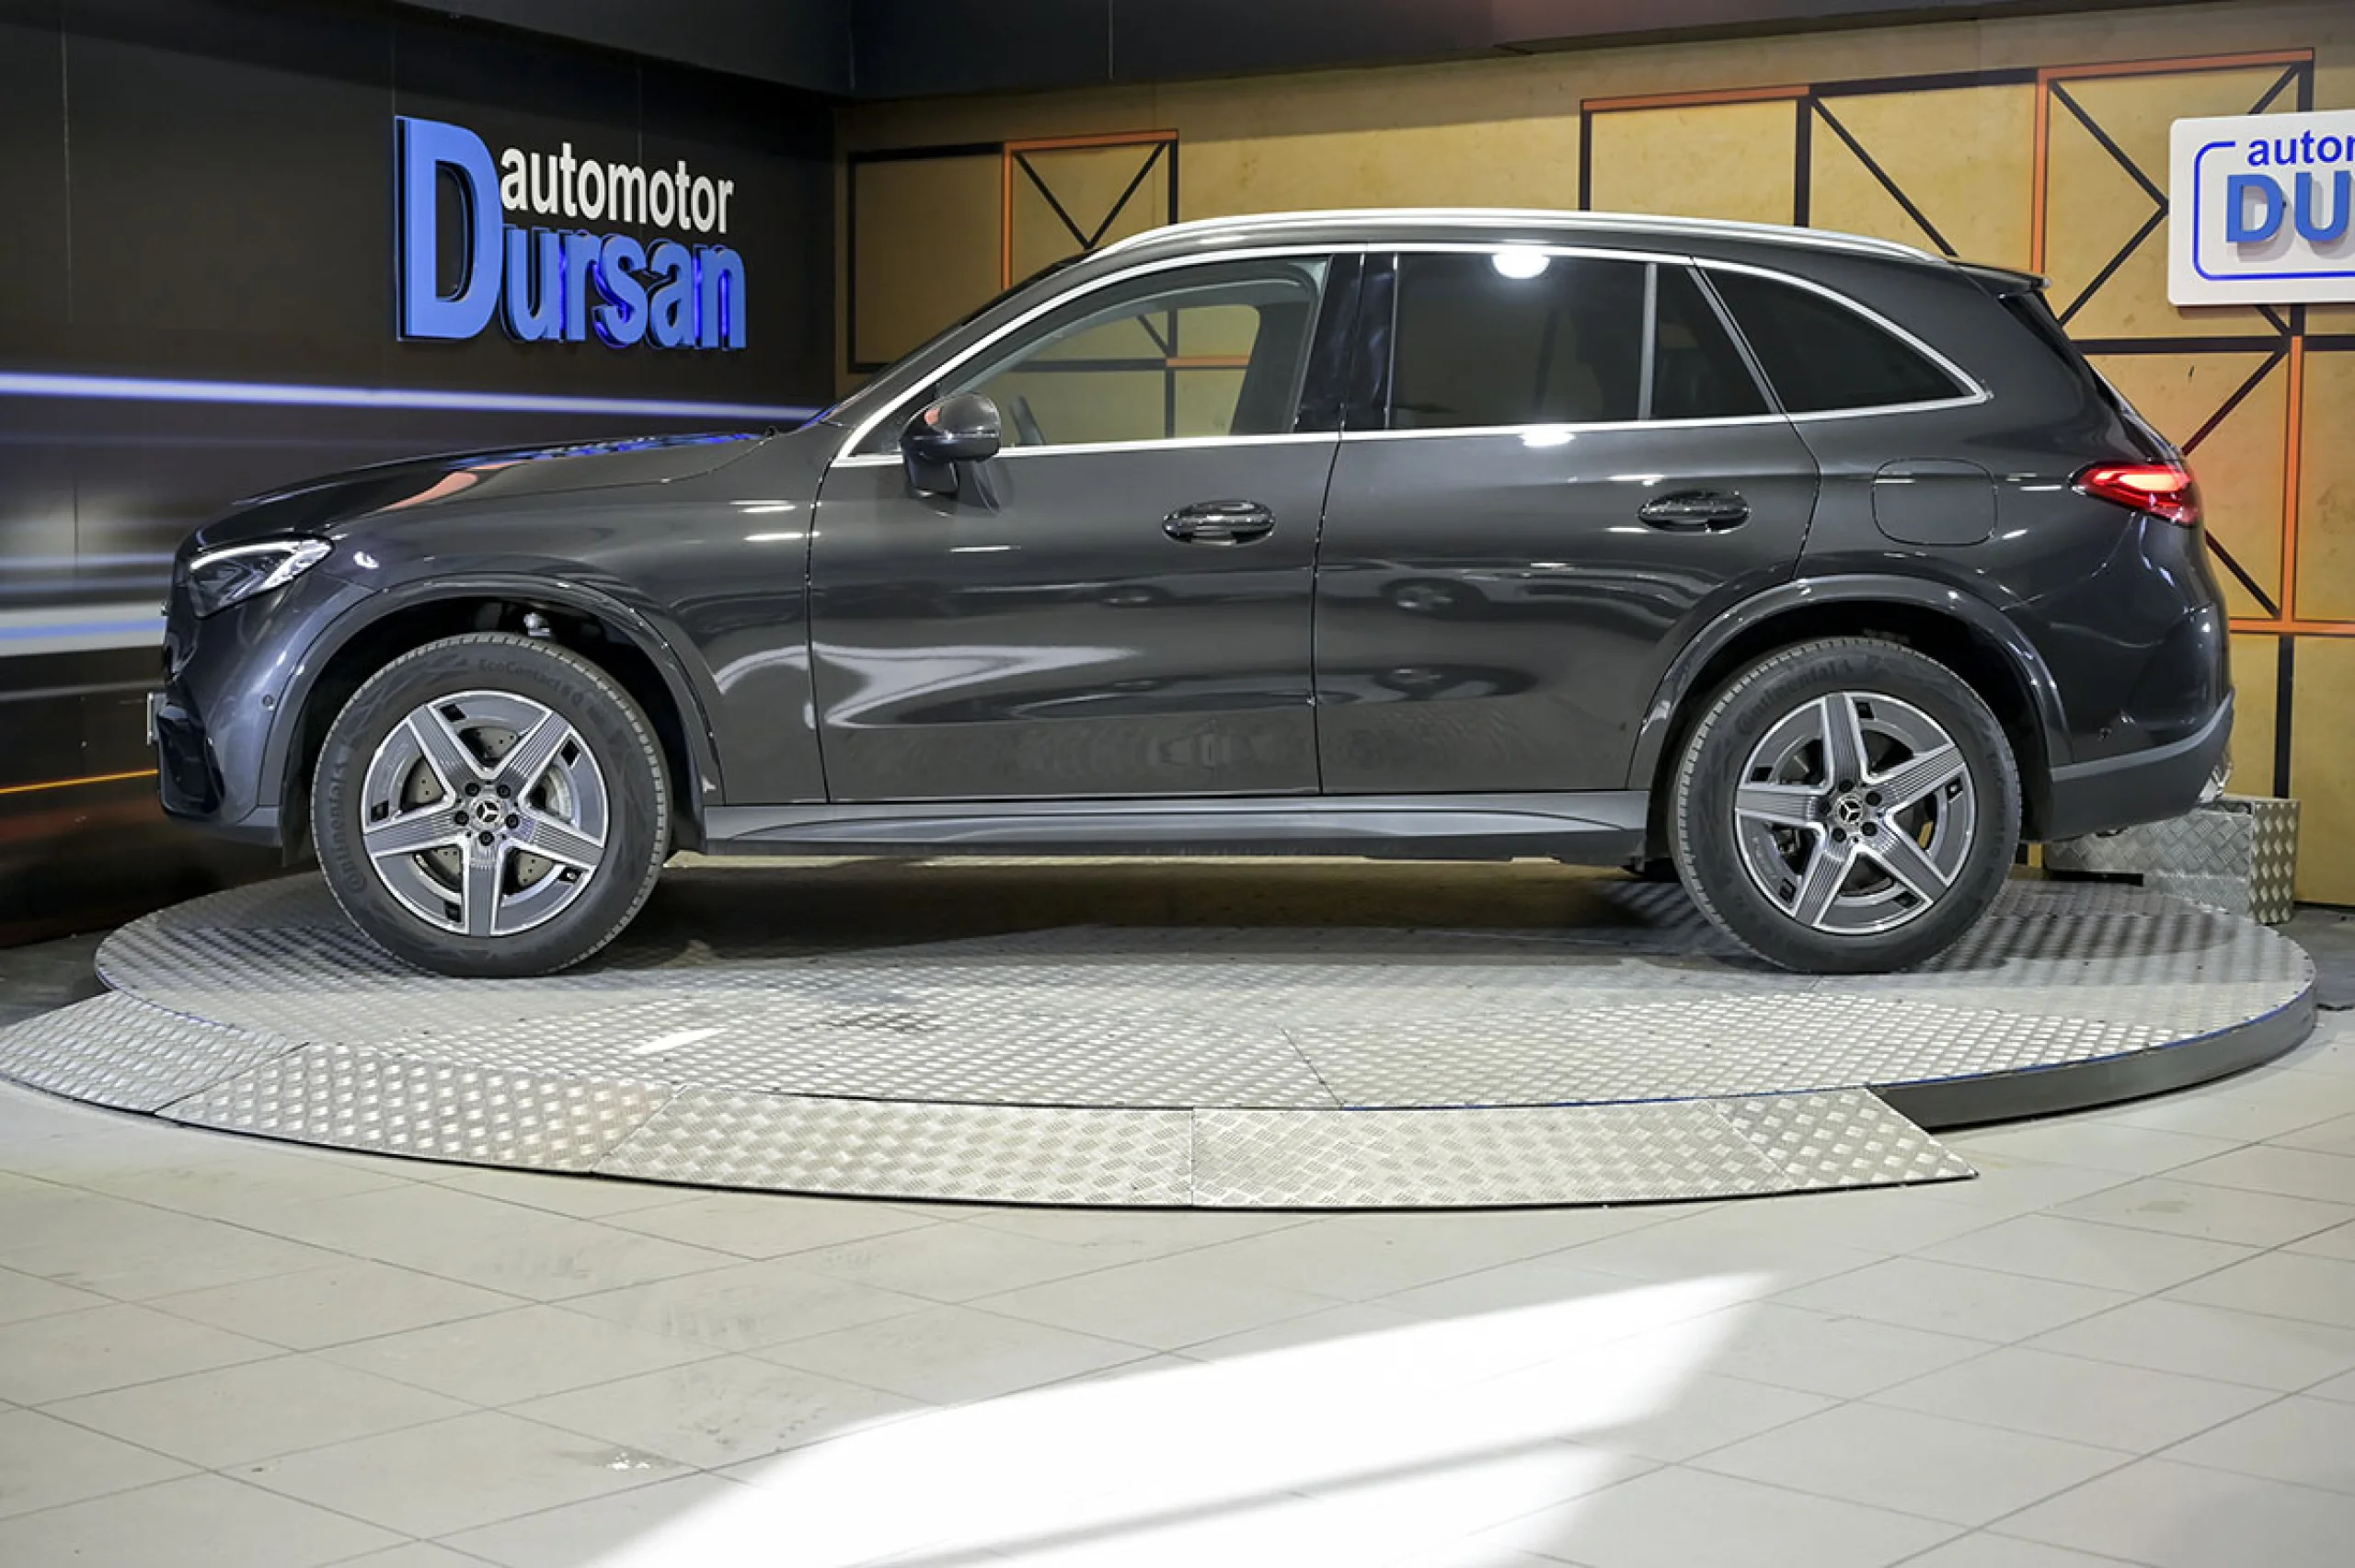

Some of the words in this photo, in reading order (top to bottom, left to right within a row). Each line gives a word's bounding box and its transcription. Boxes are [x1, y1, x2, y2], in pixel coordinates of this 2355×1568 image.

[500, 142, 735, 234] automotor
[2246, 129, 2355, 166] auto
[395, 115, 747, 349] Dursan
[477, 658, 562, 692] EcoContact
[328, 773, 367, 895] Continental
